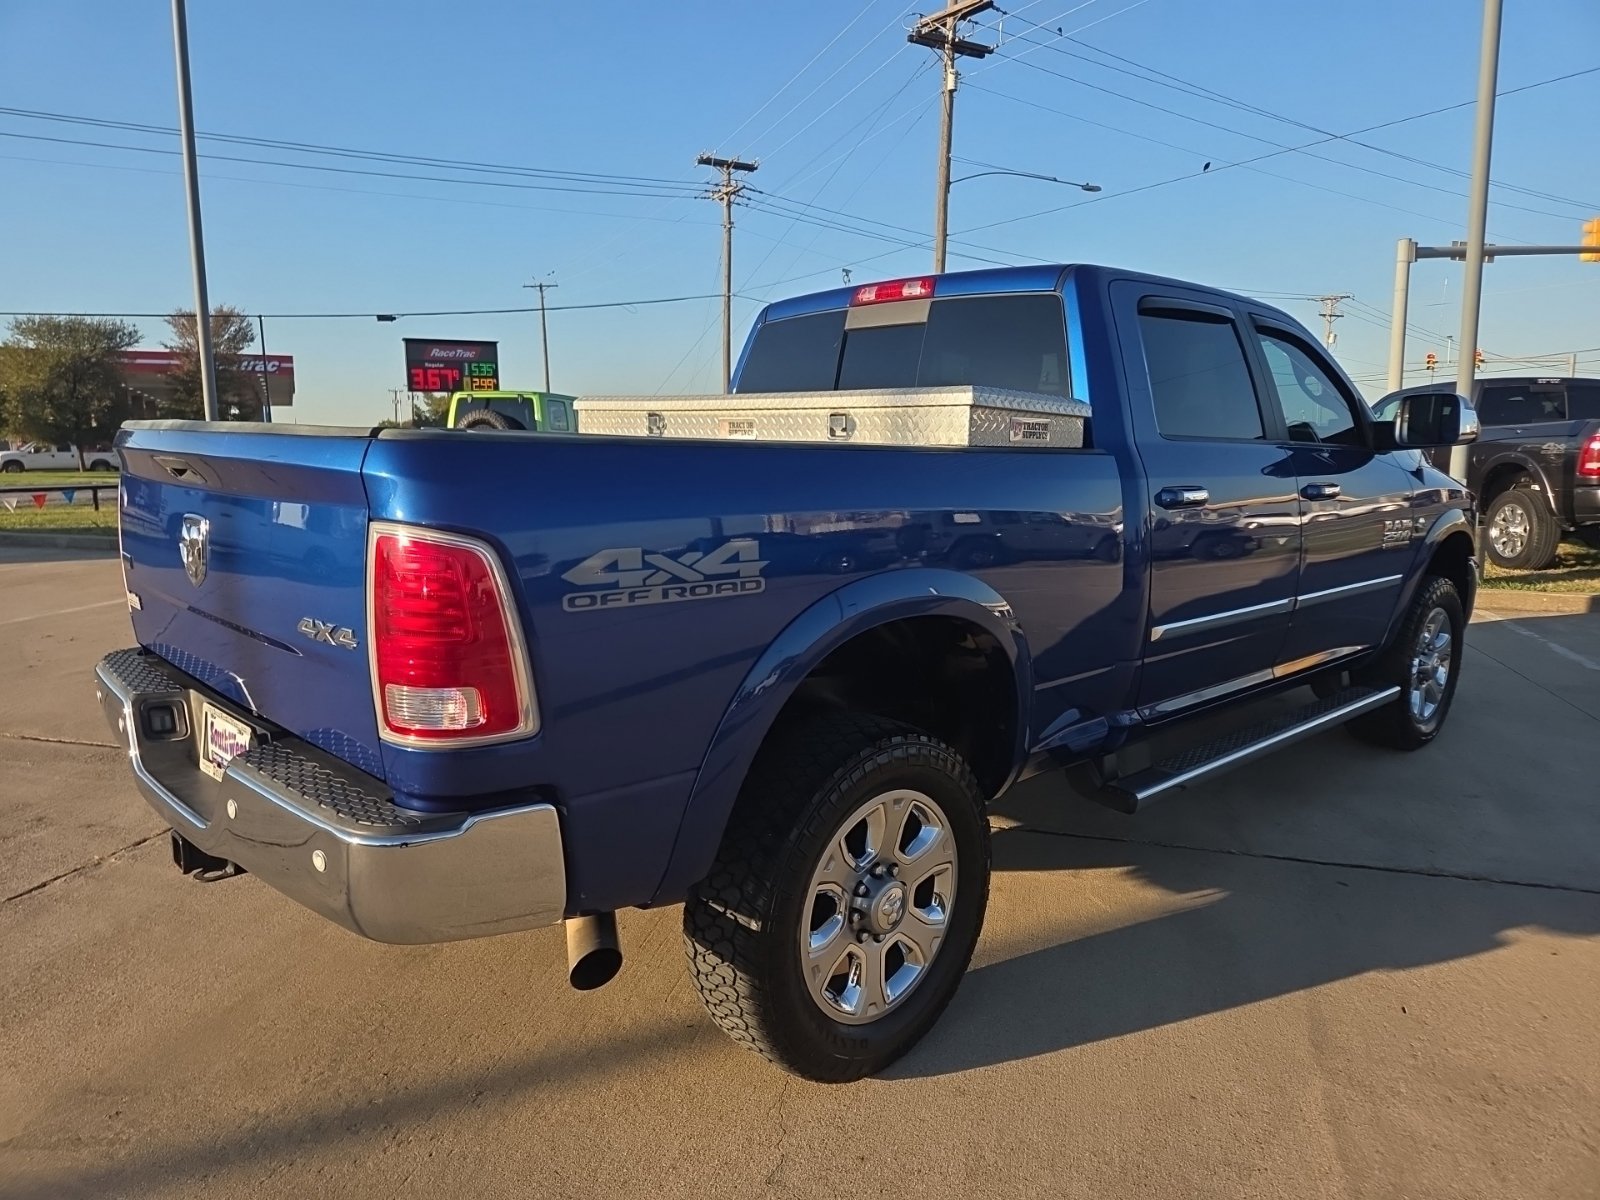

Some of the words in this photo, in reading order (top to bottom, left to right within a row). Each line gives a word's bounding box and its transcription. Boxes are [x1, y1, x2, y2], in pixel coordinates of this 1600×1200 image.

[430, 348, 476, 358] RaceTrac
[728, 421, 754, 429] TRACTOR
[1022, 421, 1049, 431] TRACTOR
[567, 588, 653, 609] OFF
[662, 578, 762, 600] ROAD
